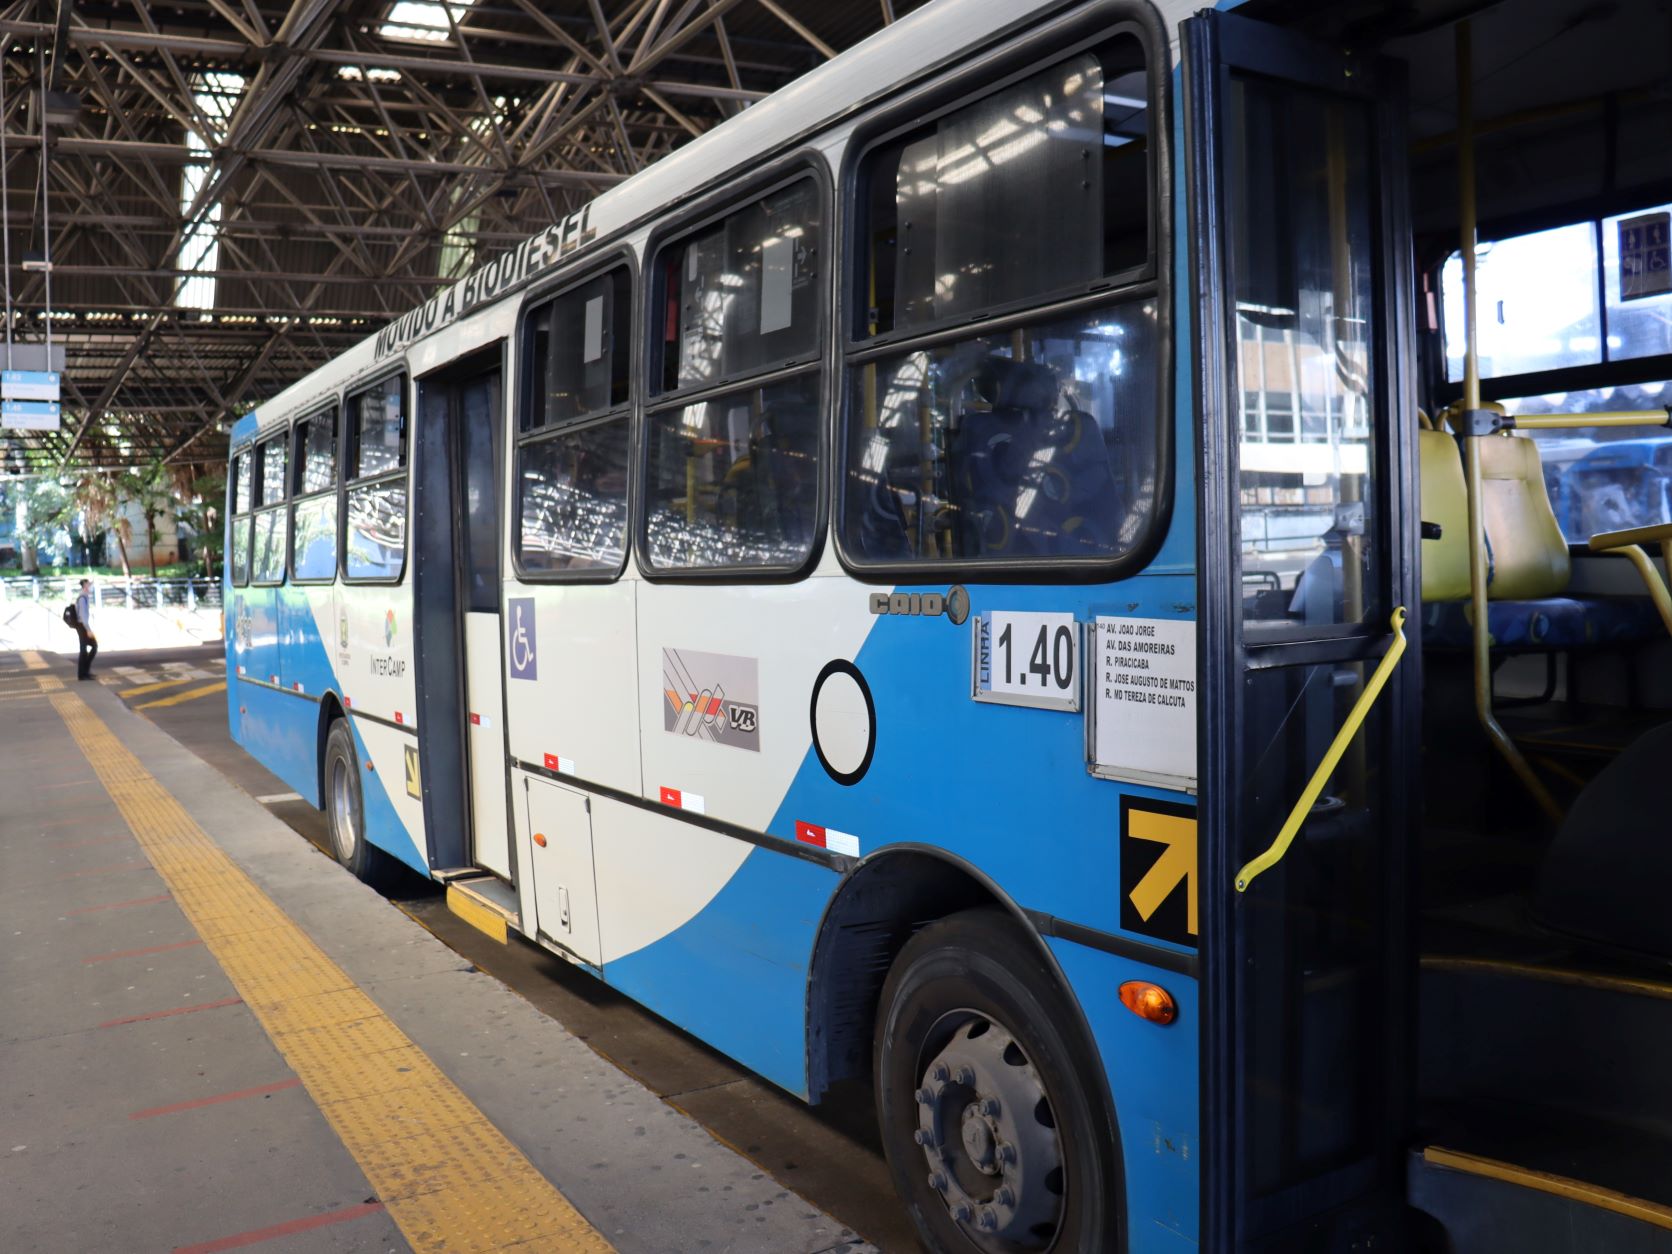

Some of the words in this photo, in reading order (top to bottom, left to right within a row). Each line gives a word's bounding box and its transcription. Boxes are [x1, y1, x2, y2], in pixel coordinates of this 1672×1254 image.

[374, 296, 438, 361] MOVIDO
[442, 287, 455, 322] A
[462, 202, 597, 310] BIODIESEL
[869, 592, 944, 616] CAIO
[1107, 624, 1116, 634] AV.
[1118, 624, 1134, 636] JOAO
[1135, 626, 1155, 637] JORGE
[980, 621, 990, 684] LINHA
[999, 623, 1073, 690] 1.40
[1106, 640, 1116, 650] AV.
[1118, 640, 1132, 653] DAS
[1134, 642, 1175, 655] AMOREIRAS
[1106, 656, 1113, 667] R.
[1115, 657, 1149, 669] PIRACICABA
[1105, 672, 1113, 683] R.
[1114, 673, 1129, 685] JOSE
[1130, 675, 1159, 688] AUGUSTO
[1159, 678, 1168, 689] DE
[1169, 679, 1195, 692] MATTOS
[1105, 688, 1112, 699] R.
[1125, 690, 1146, 703] TEREZA
[1147, 693, 1156, 704] DE
[1158, 695, 1185, 707] CALCUTA
